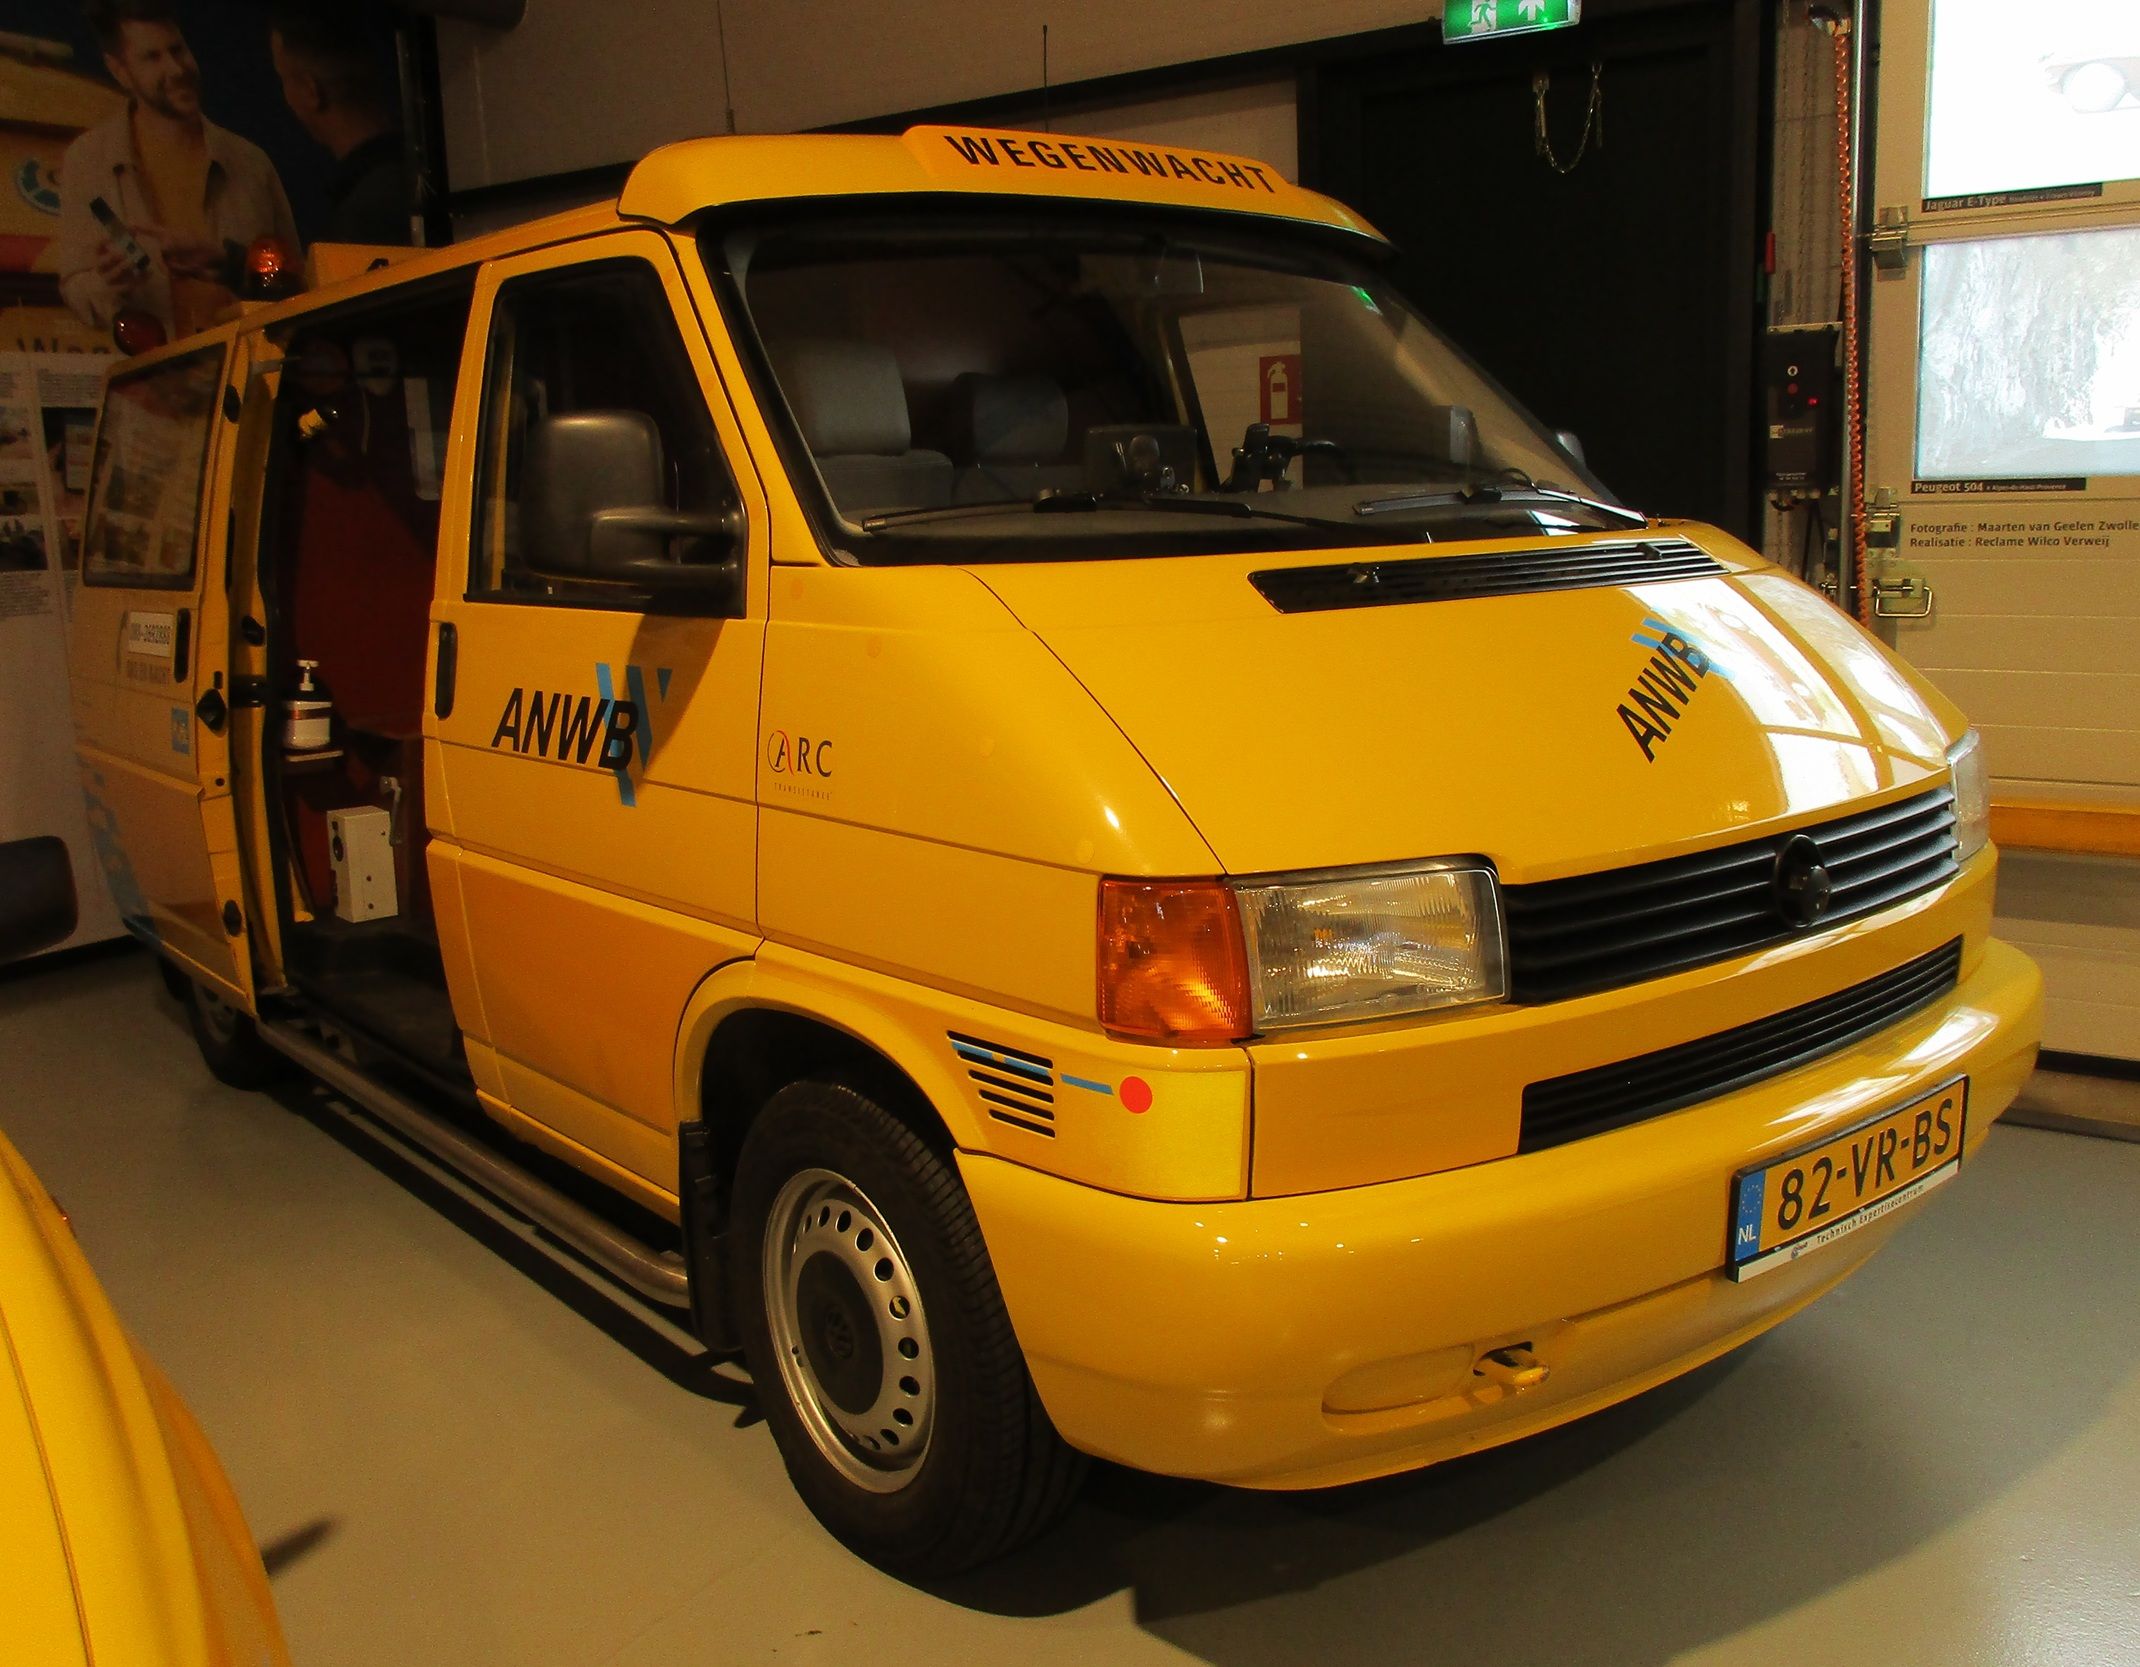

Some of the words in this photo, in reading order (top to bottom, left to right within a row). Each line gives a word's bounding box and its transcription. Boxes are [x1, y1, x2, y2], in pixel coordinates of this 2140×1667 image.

[945, 135, 1275, 193] WEGENWACHT
[1925, 197, 1963, 211] Jaguar
[1914, 482, 1961, 494] Peugeot
[1963, 481, 1983, 493] 504
[1910, 522, 1967, 534] Fotografie
[1978, 522, 2025, 533] Maarten
[2029, 522, 2049, 532] van
[2054, 520, 2094, 532] Geelen
[2099, 520, 2139, 531] Zwolle
[1910, 536, 1965, 548] Realisatie
[1975, 535, 2024, 547] Reclame
[2028, 535, 2060, 546] Wilco
[2064, 535, 2110, 548] Verweij
[1616, 632, 1710, 764] ANWB
[491, 687, 639, 771] ANWB
[767, 730, 833, 778] ARC
[1777, 1098, 1952, 1231] 82-VR-BS
[1737, 1225, 1757, 1245] NL
[1816, 1219, 1857, 1245] Technisch
